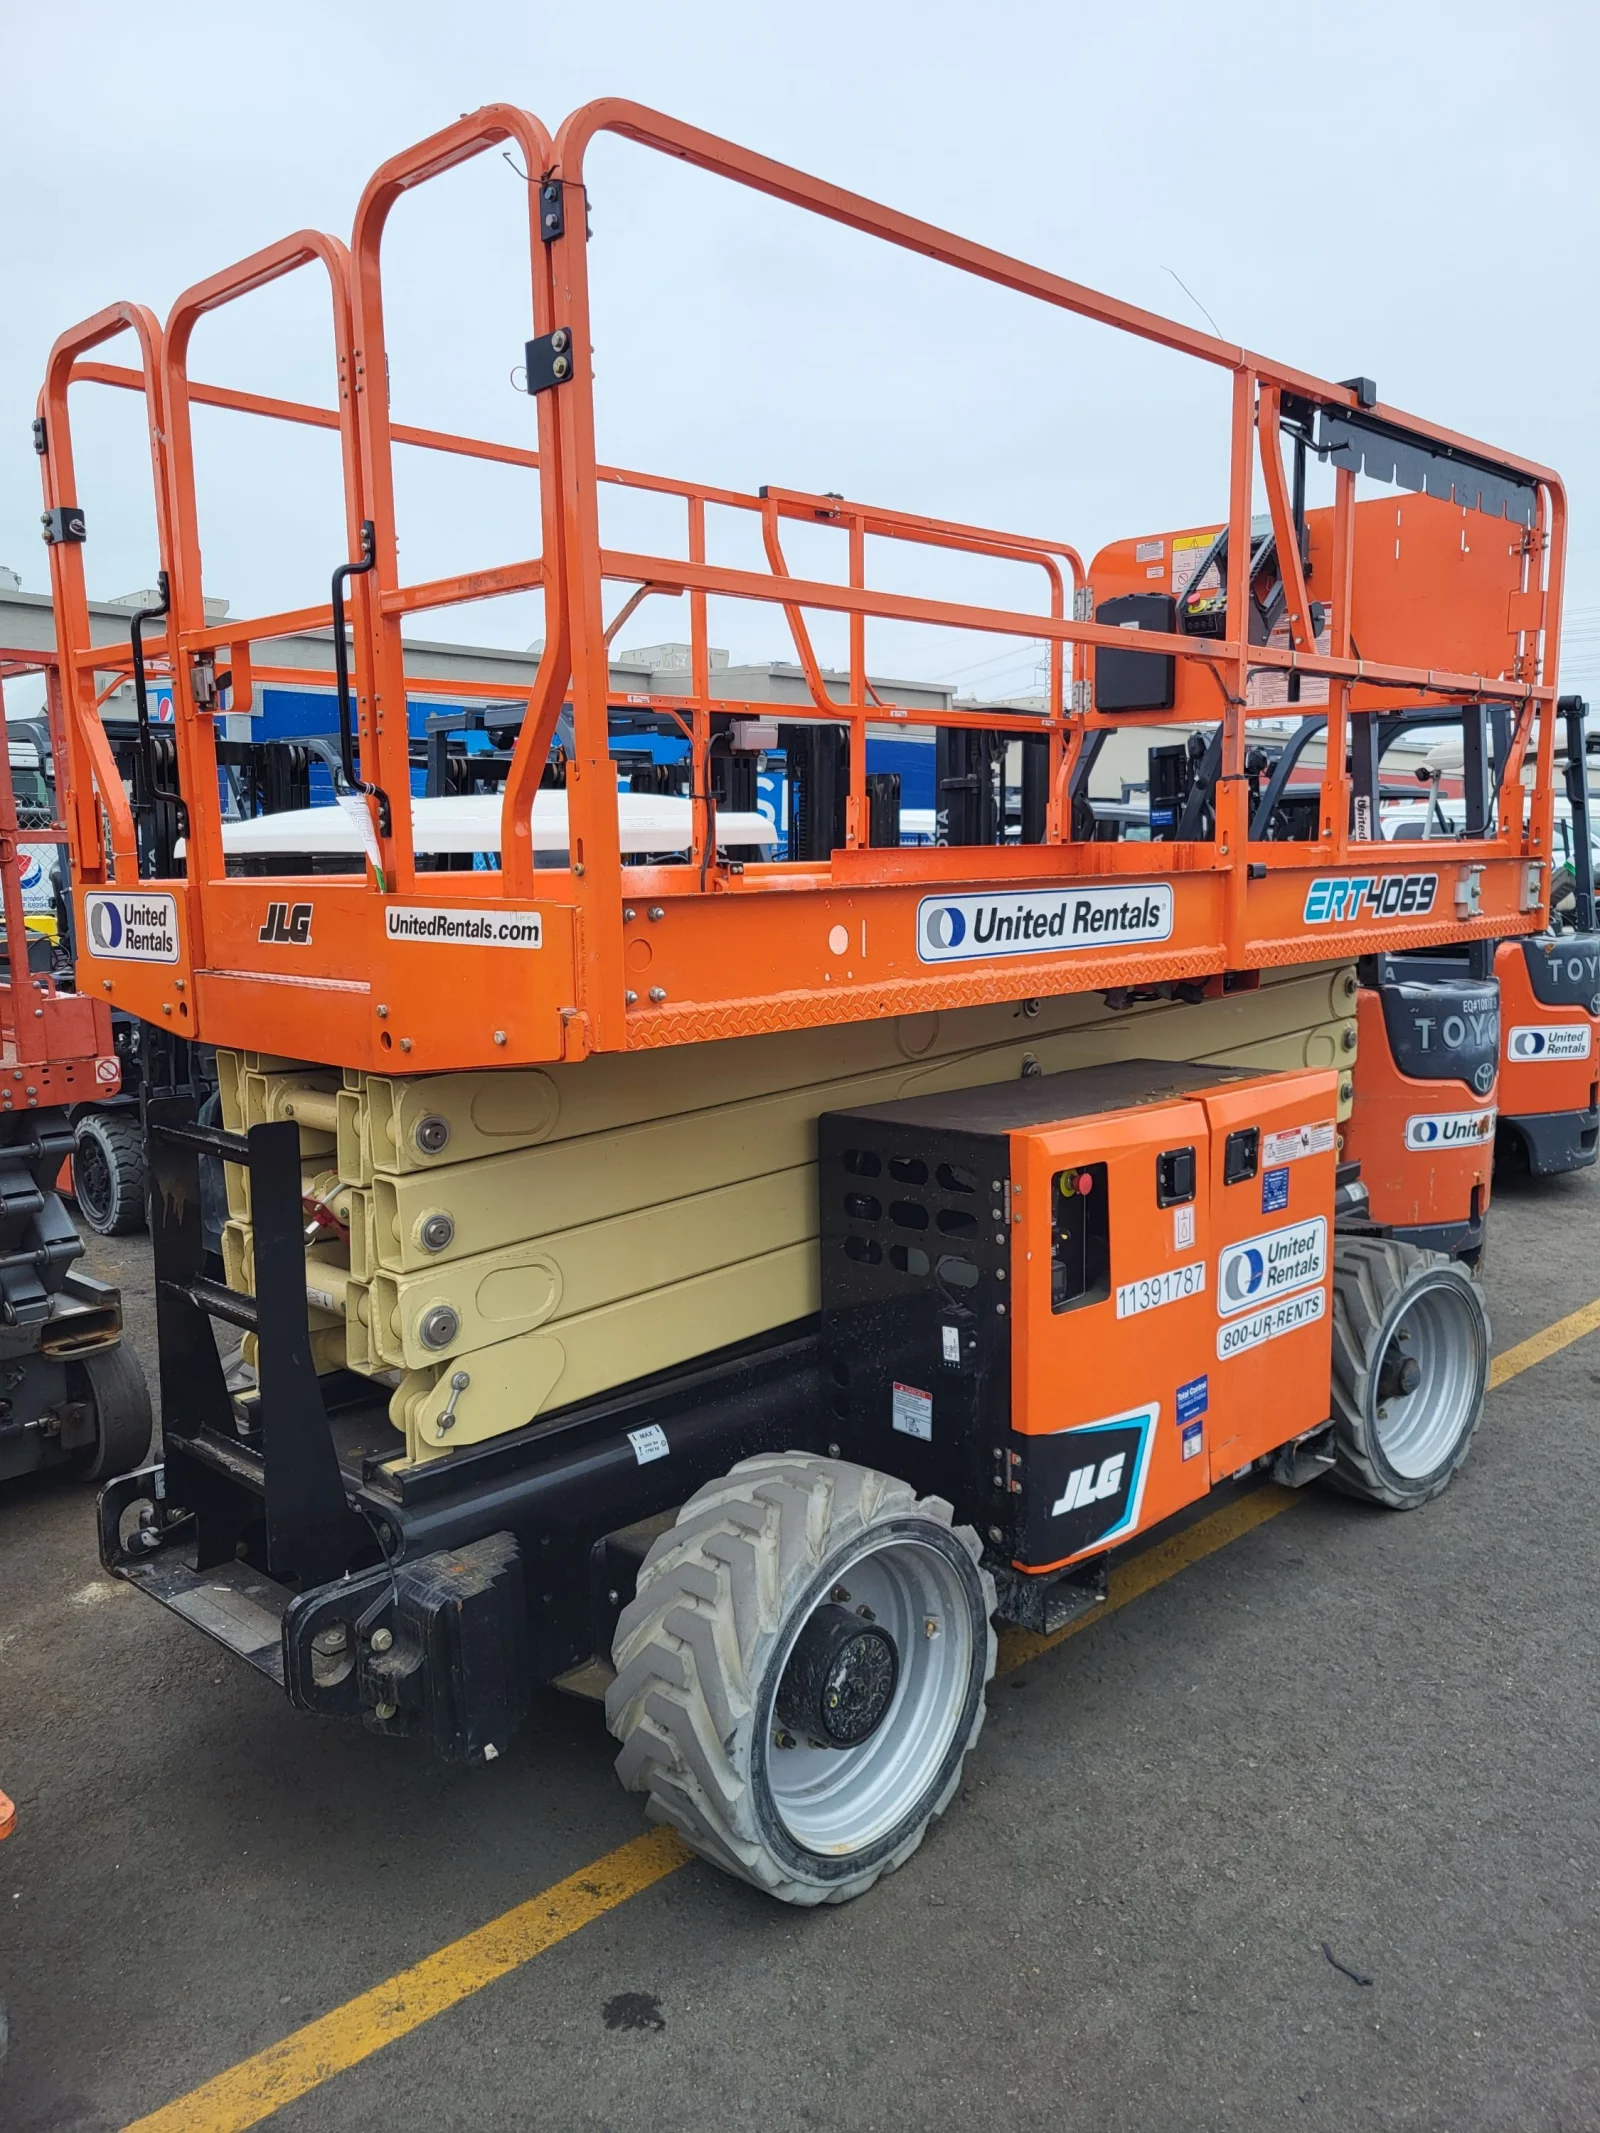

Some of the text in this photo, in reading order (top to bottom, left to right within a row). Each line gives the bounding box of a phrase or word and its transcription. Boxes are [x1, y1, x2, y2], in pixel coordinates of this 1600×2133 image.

[124, 903, 167, 927] United
[1305, 875, 1437, 921] ERT4069
[258, 902, 313, 945] JLG
[389, 913, 539, 941] UnitedRentals.com
[974, 897, 1161, 943] United Rentals
[126, 929, 173, 952] Rentals
[1547, 1043, 1586, 1054] Rentals
[1548, 1031, 1584, 1042] United
[1267, 1229, 1316, 1263] United
[1266, 1254, 1319, 1288] Rentals
[1119, 1263, 1203, 1315] 11391787
[1223, 1296, 1319, 1350] 800-UR-RENTS
[1052, 1452, 1126, 1517] JLG
